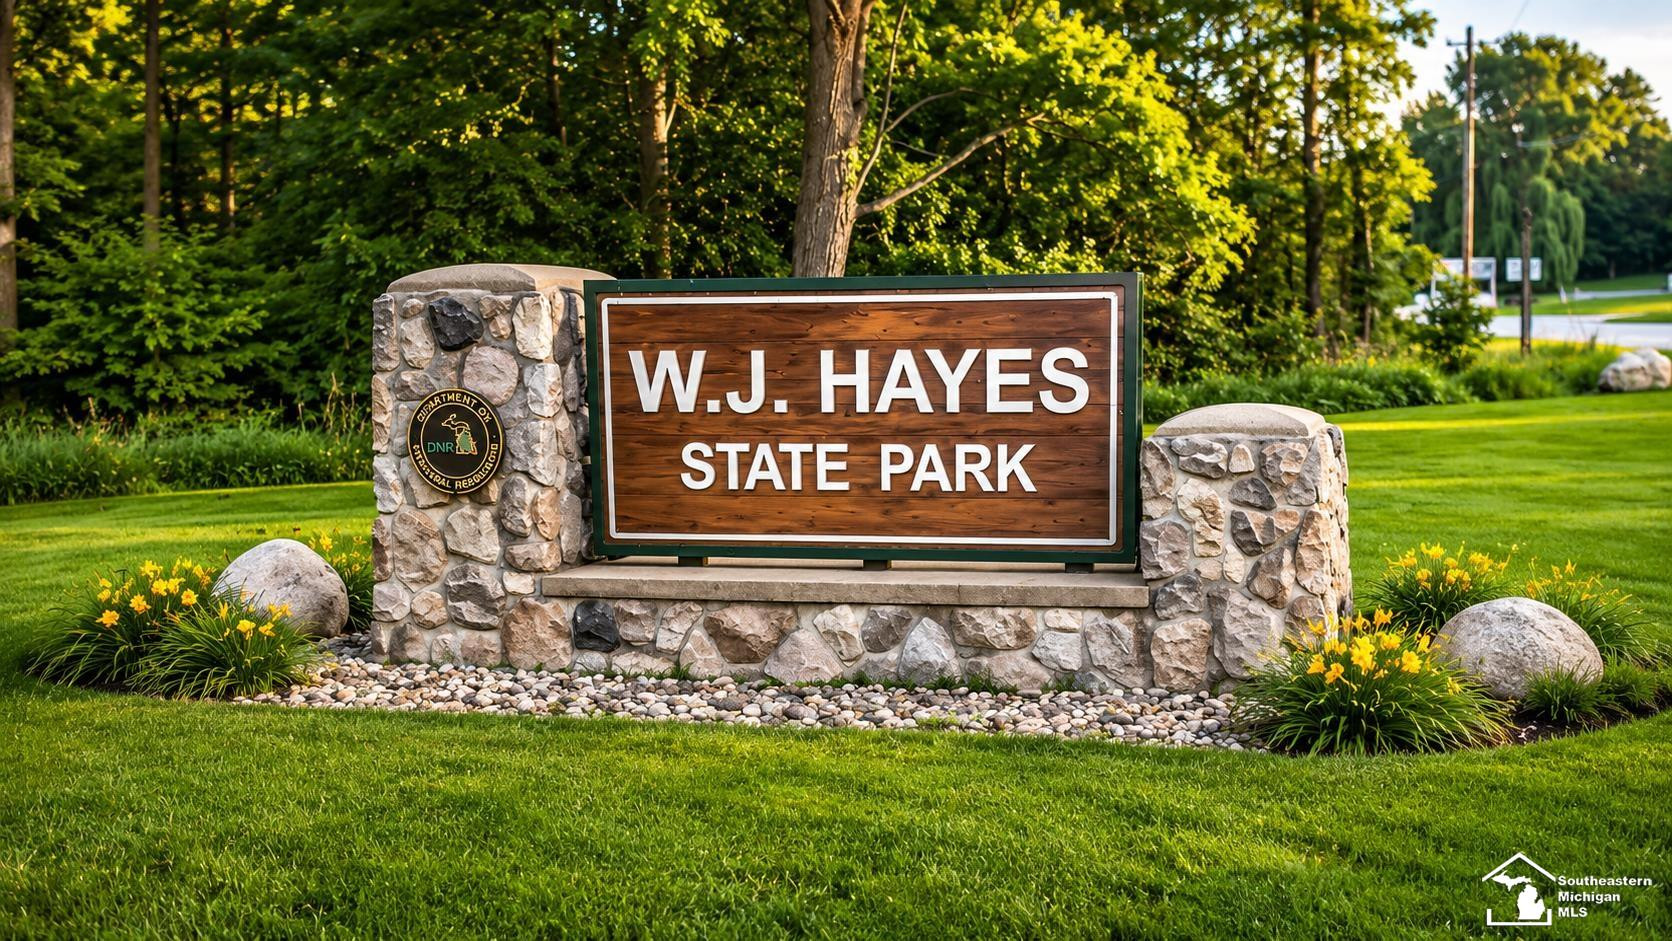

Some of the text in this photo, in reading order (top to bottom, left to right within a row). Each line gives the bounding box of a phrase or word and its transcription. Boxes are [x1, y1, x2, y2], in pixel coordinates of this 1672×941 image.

[629, 347, 1090, 414] W.J. HAYES
[427, 442, 454, 453] DNR
[680, 442, 1037, 492] STATE PARK
